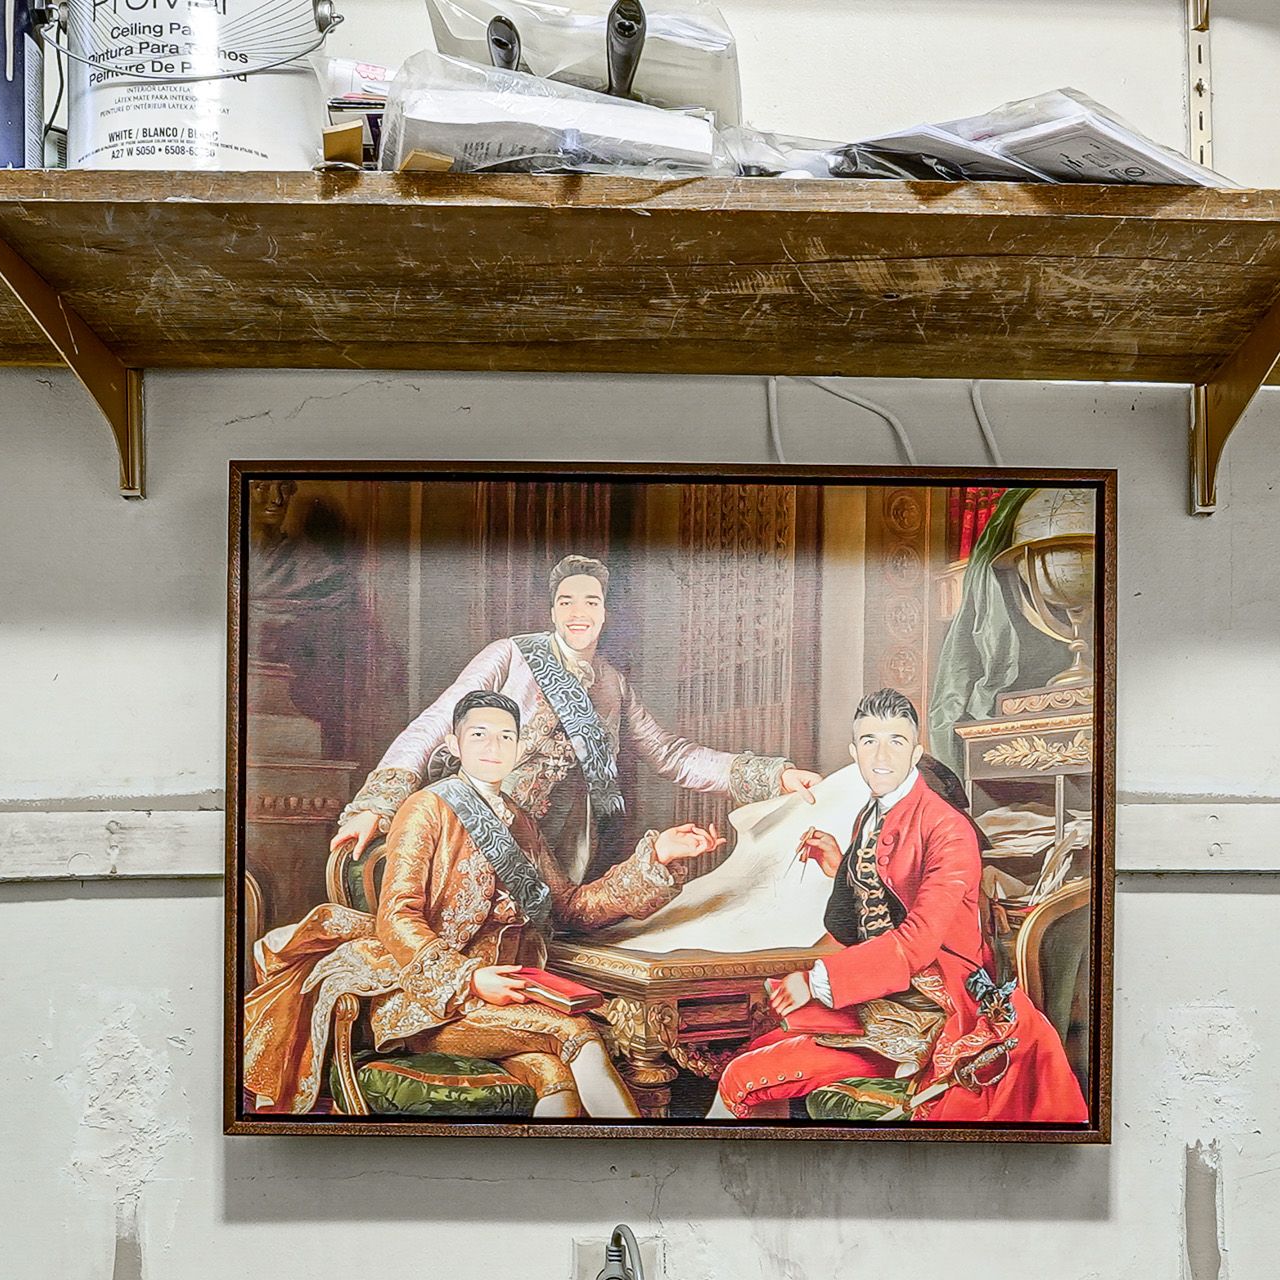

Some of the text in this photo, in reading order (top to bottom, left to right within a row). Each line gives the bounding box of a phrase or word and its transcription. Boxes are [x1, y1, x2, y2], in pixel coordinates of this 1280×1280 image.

[110, 22, 163, 38] Ceiling
[139, 41, 179, 54] Para
[151, 60, 175, 73] De
[157, 85, 177, 93] LATEX
[179, 85, 192, 93] FLA
[168, 102, 187, 110] LATEX
[108, 128, 133, 143] WHITE
[142, 127, 178, 138] BLANCO
[111, 147, 124, 160] A27
[126, 146, 134, 157] W
[136, 145, 156, 156] 5050
